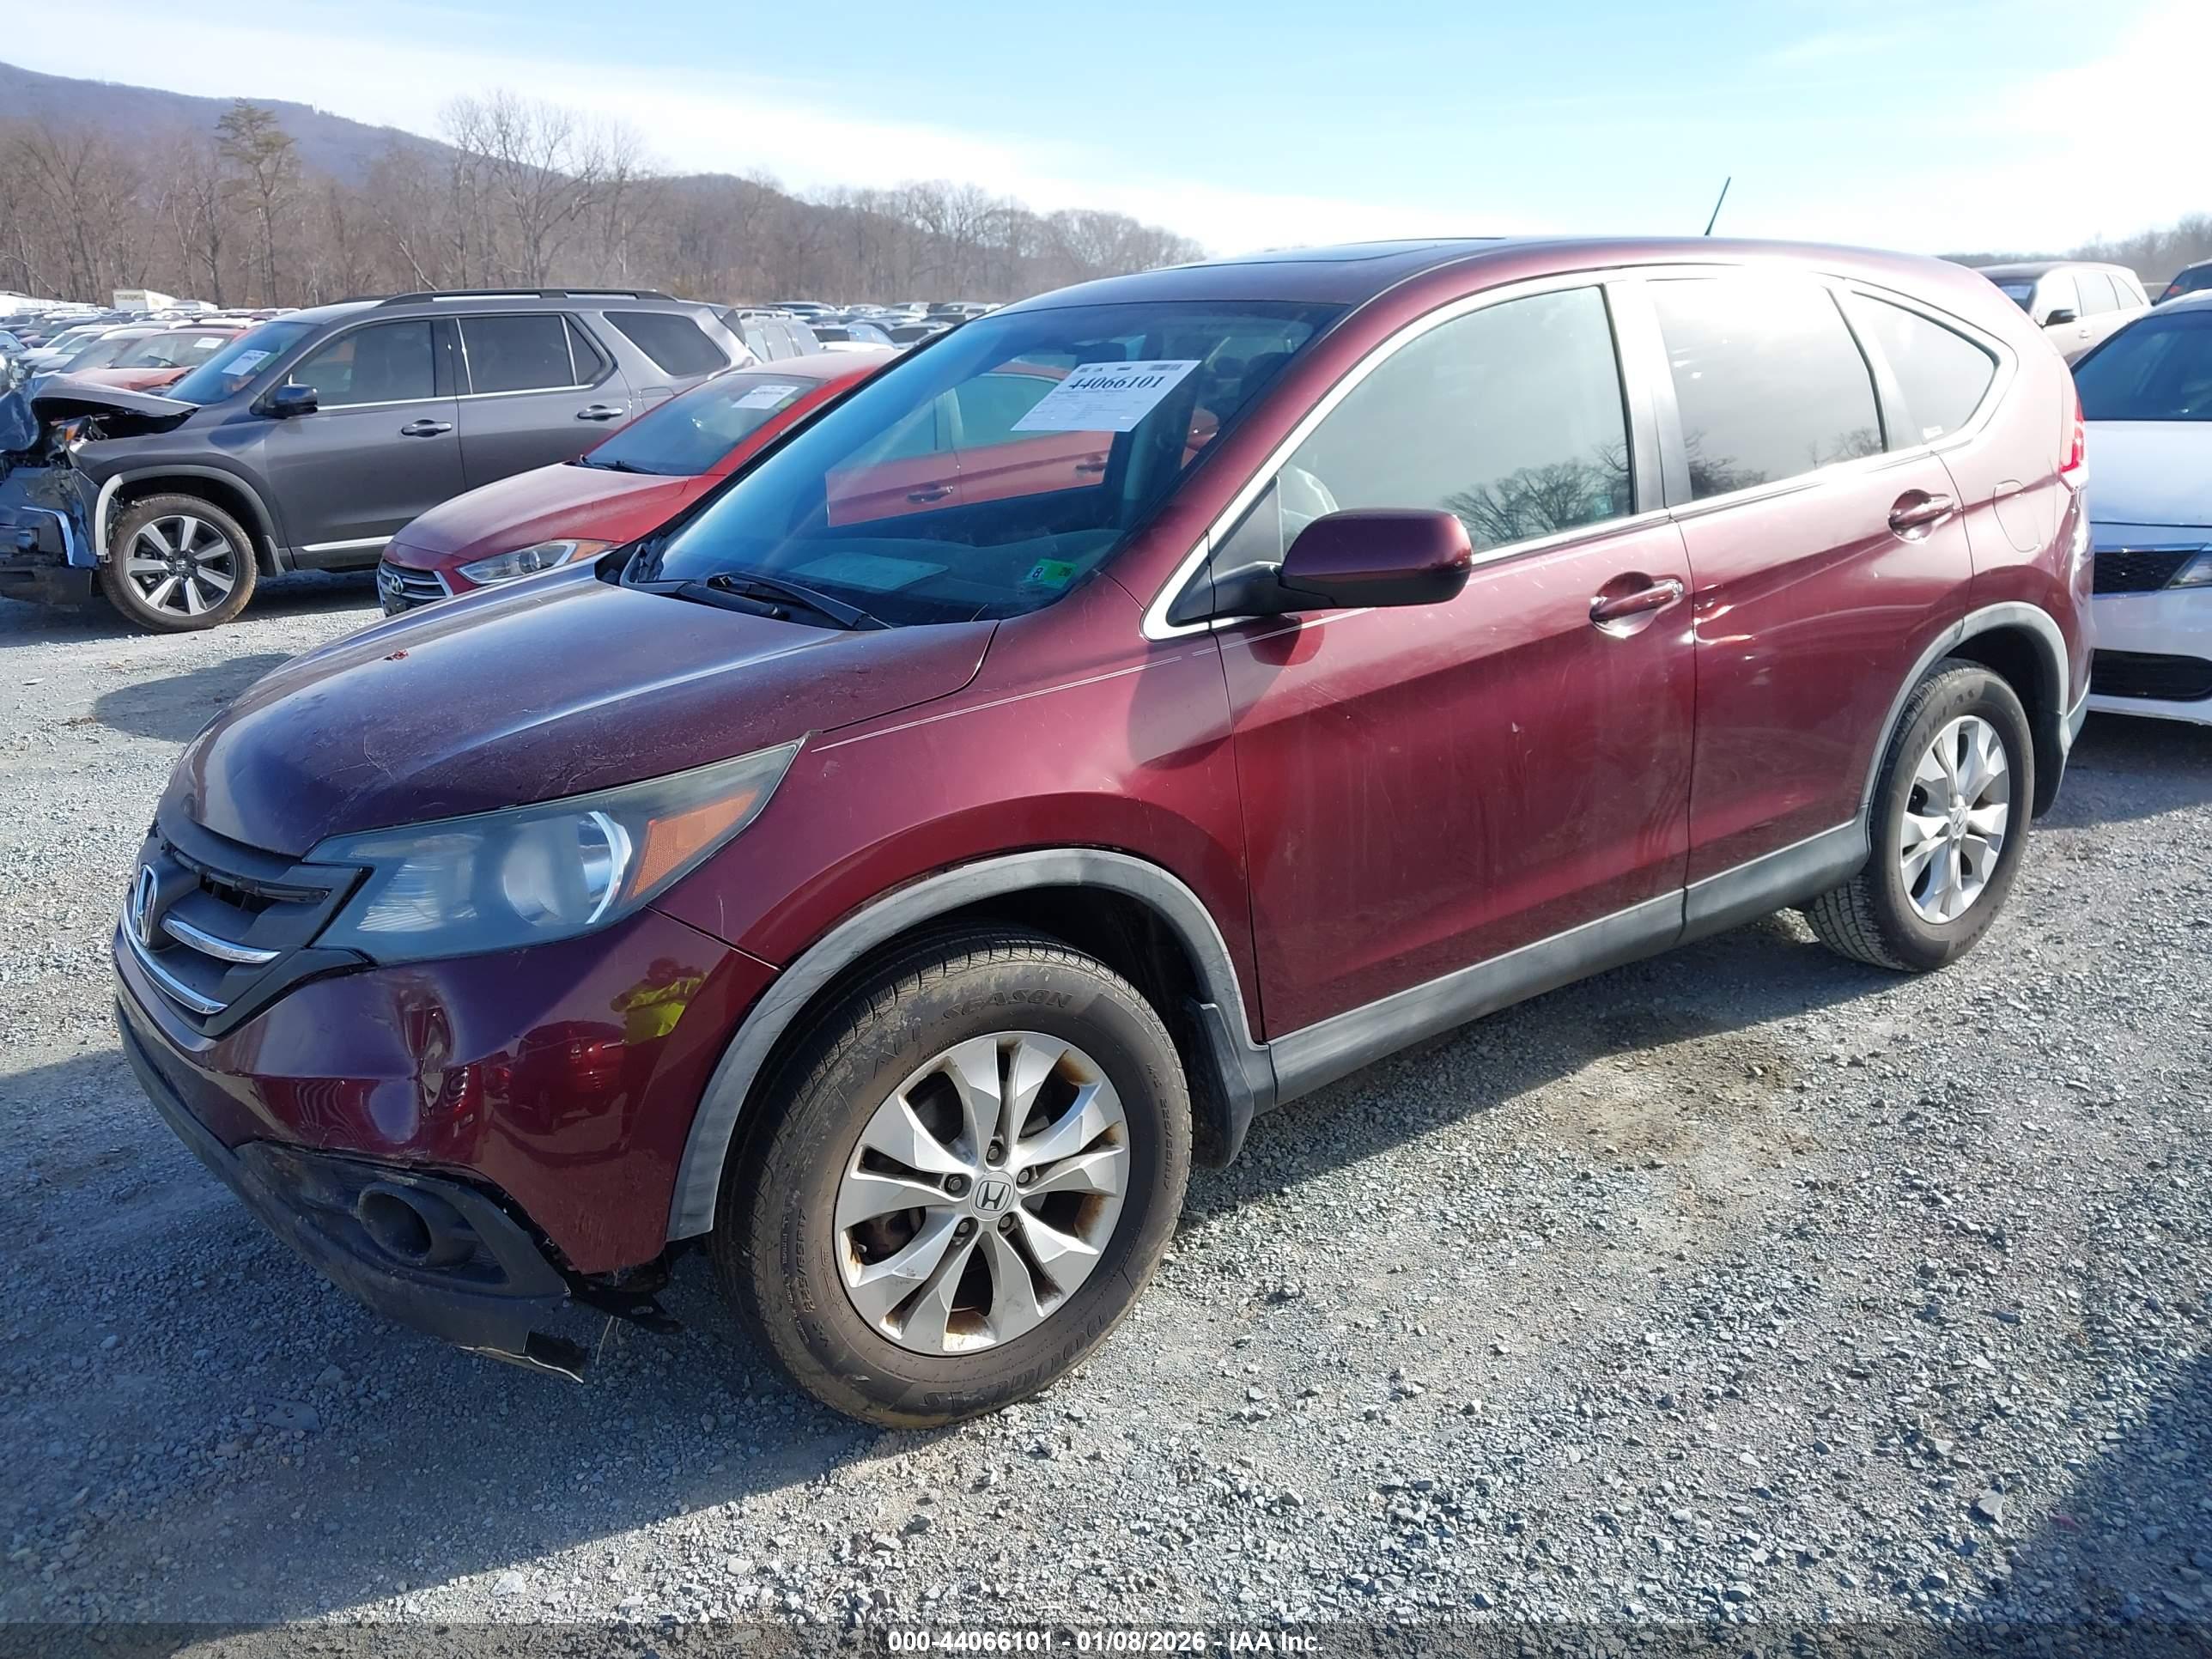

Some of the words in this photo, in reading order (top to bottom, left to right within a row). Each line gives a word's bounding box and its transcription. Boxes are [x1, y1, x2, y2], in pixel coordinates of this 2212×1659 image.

[1069, 376, 1166, 390] 44066101
[1032, 568, 1044, 578] 8
[942, 988, 1073, 1019] SEASON
